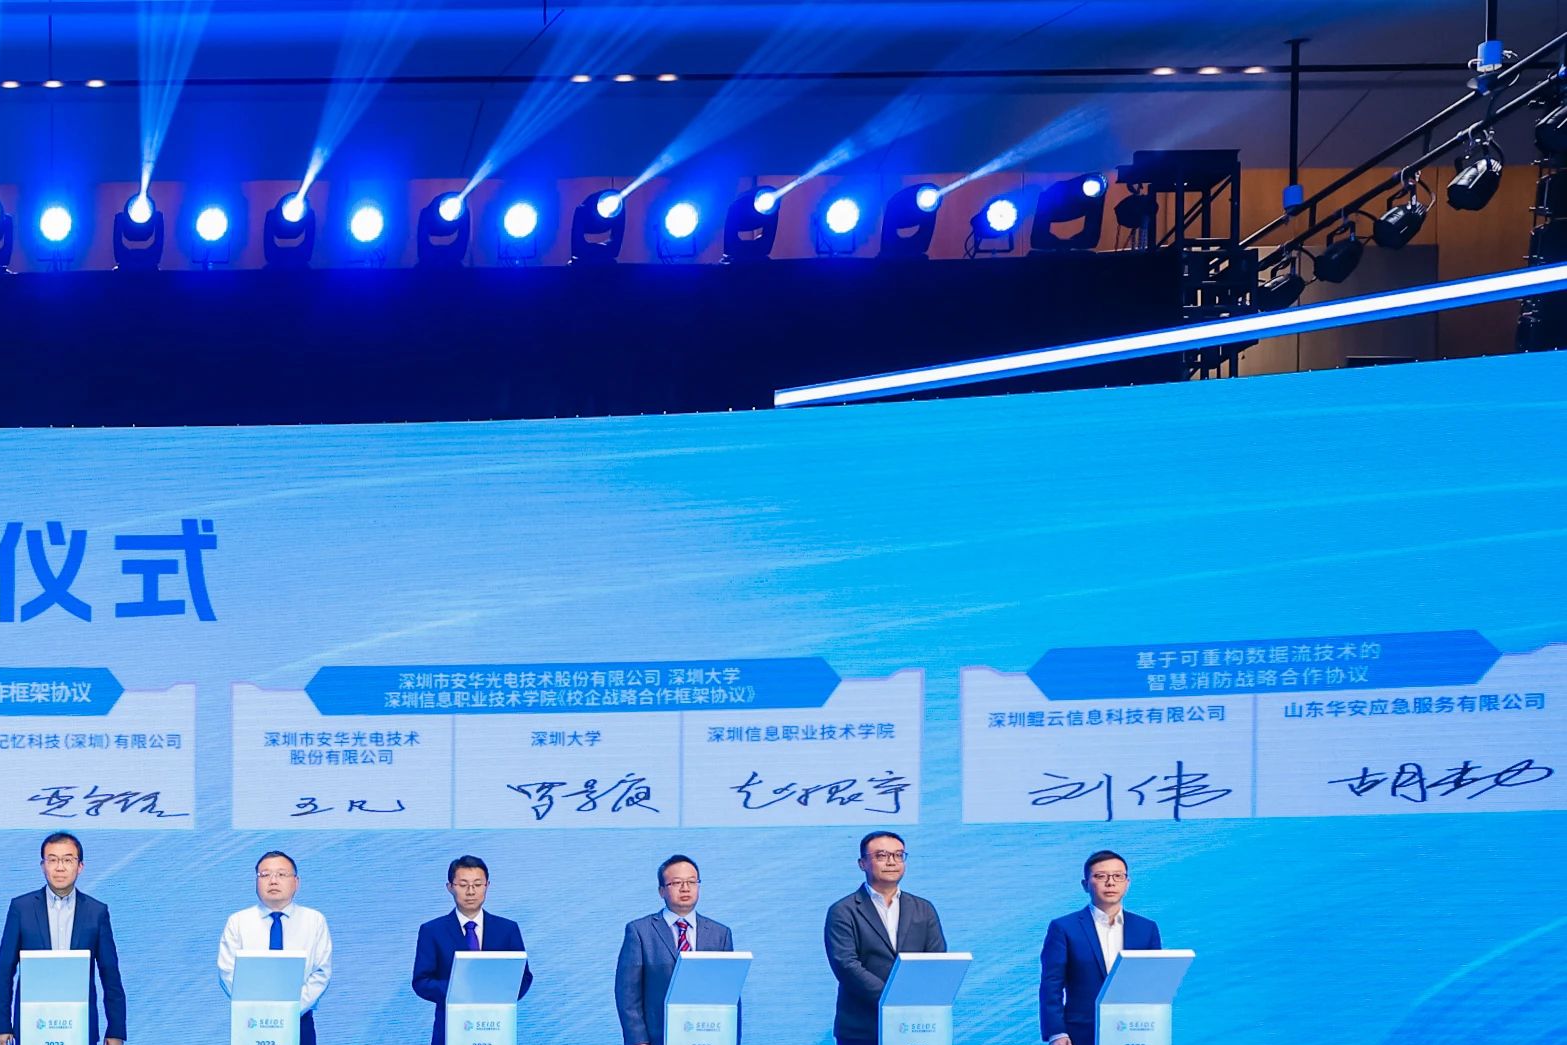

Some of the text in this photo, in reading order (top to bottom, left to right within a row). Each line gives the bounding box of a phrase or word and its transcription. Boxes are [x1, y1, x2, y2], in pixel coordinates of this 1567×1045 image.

[1136, 642, 1381, 670] 基于可重构数据流技术的
[398, 667, 741, 690] 深圳市安华光电技术股份有限公司 深圳大学
[1147, 665, 1369, 693] 智慧消防战略合作协议
[988, 704, 1225, 729] 深圳鲲云信息科技有限公司
[1283, 692, 1545, 720] 山东华安应急服务有限公司
[264, 730, 420, 749] 深圳市安华光电技术
[531, 730, 601, 748] 深圳大学
[707, 723, 895, 743] 深圳信息职业技术学院
[289, 749, 394, 765] 股份有限公司
